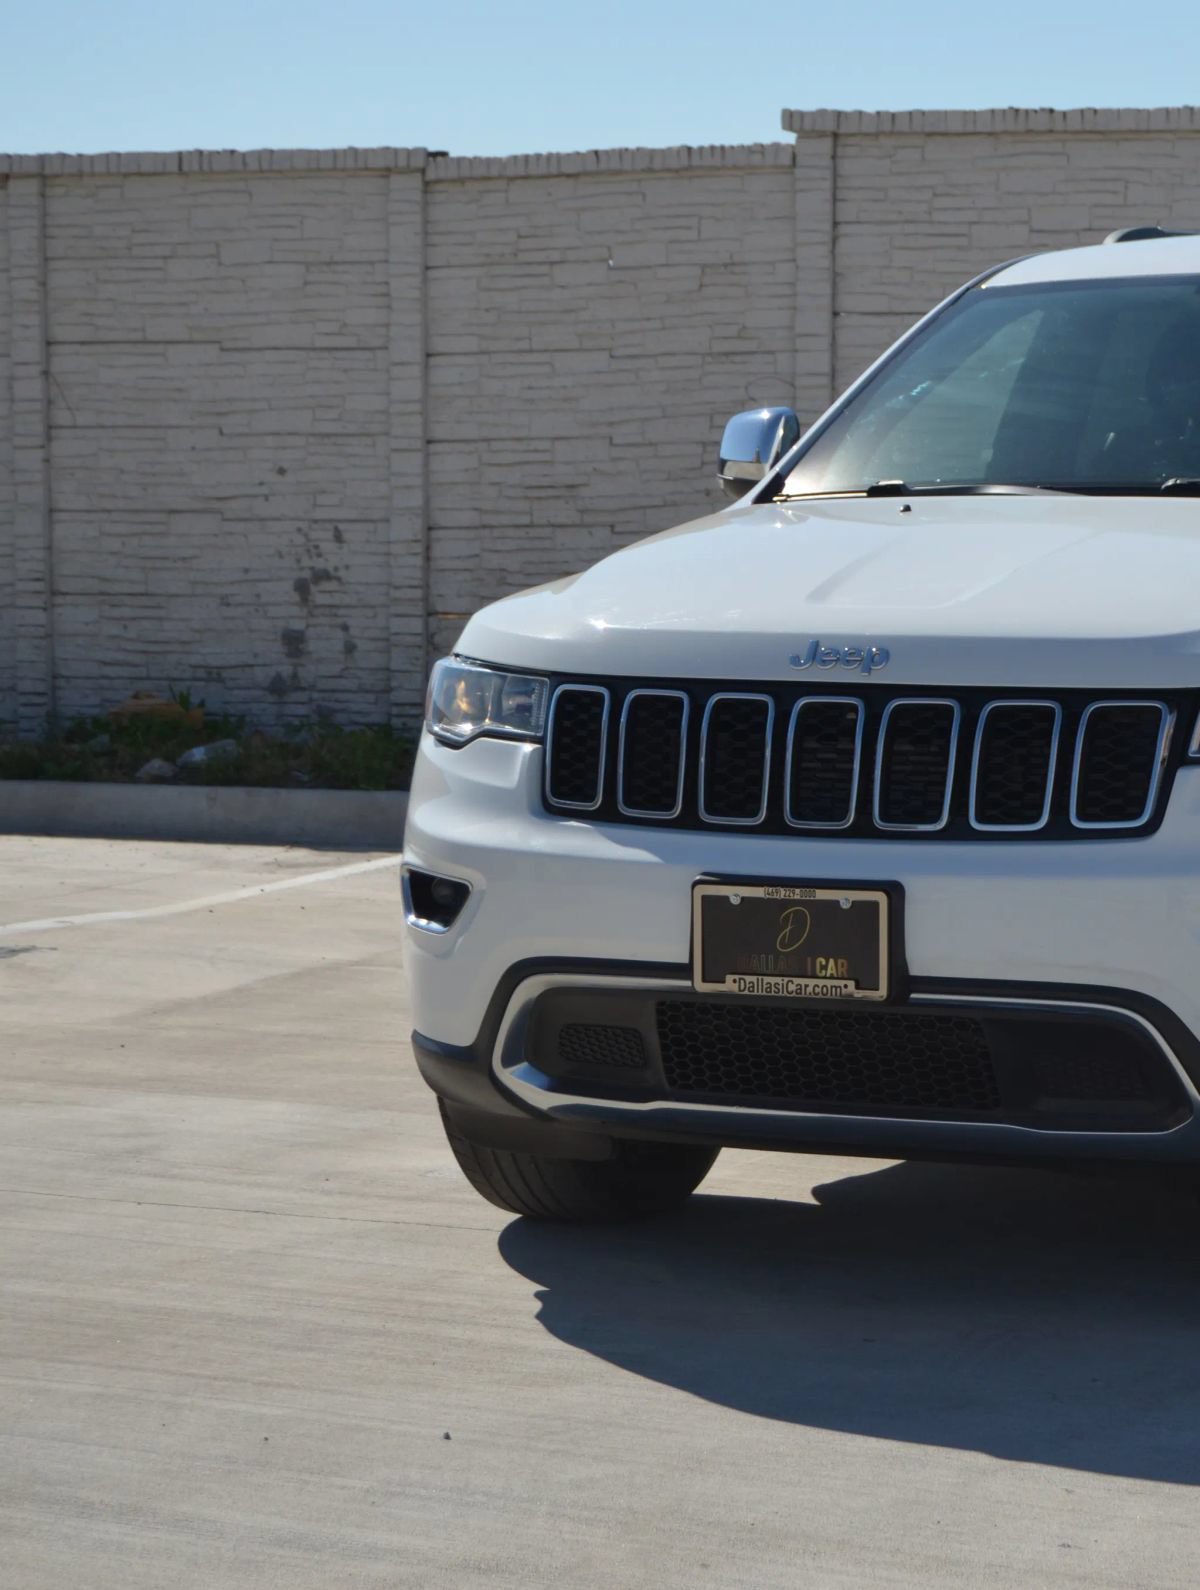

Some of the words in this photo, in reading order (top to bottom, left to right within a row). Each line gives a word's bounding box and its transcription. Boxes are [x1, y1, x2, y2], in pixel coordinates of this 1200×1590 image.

[789, 639, 890, 676] Jeep
[764, 887, 782, 899] (469)
[783, 888, 817, 899] 229-0000
[737, 953, 799, 974] ALLA
[738, 976, 843, 998] DallasiCar.com
